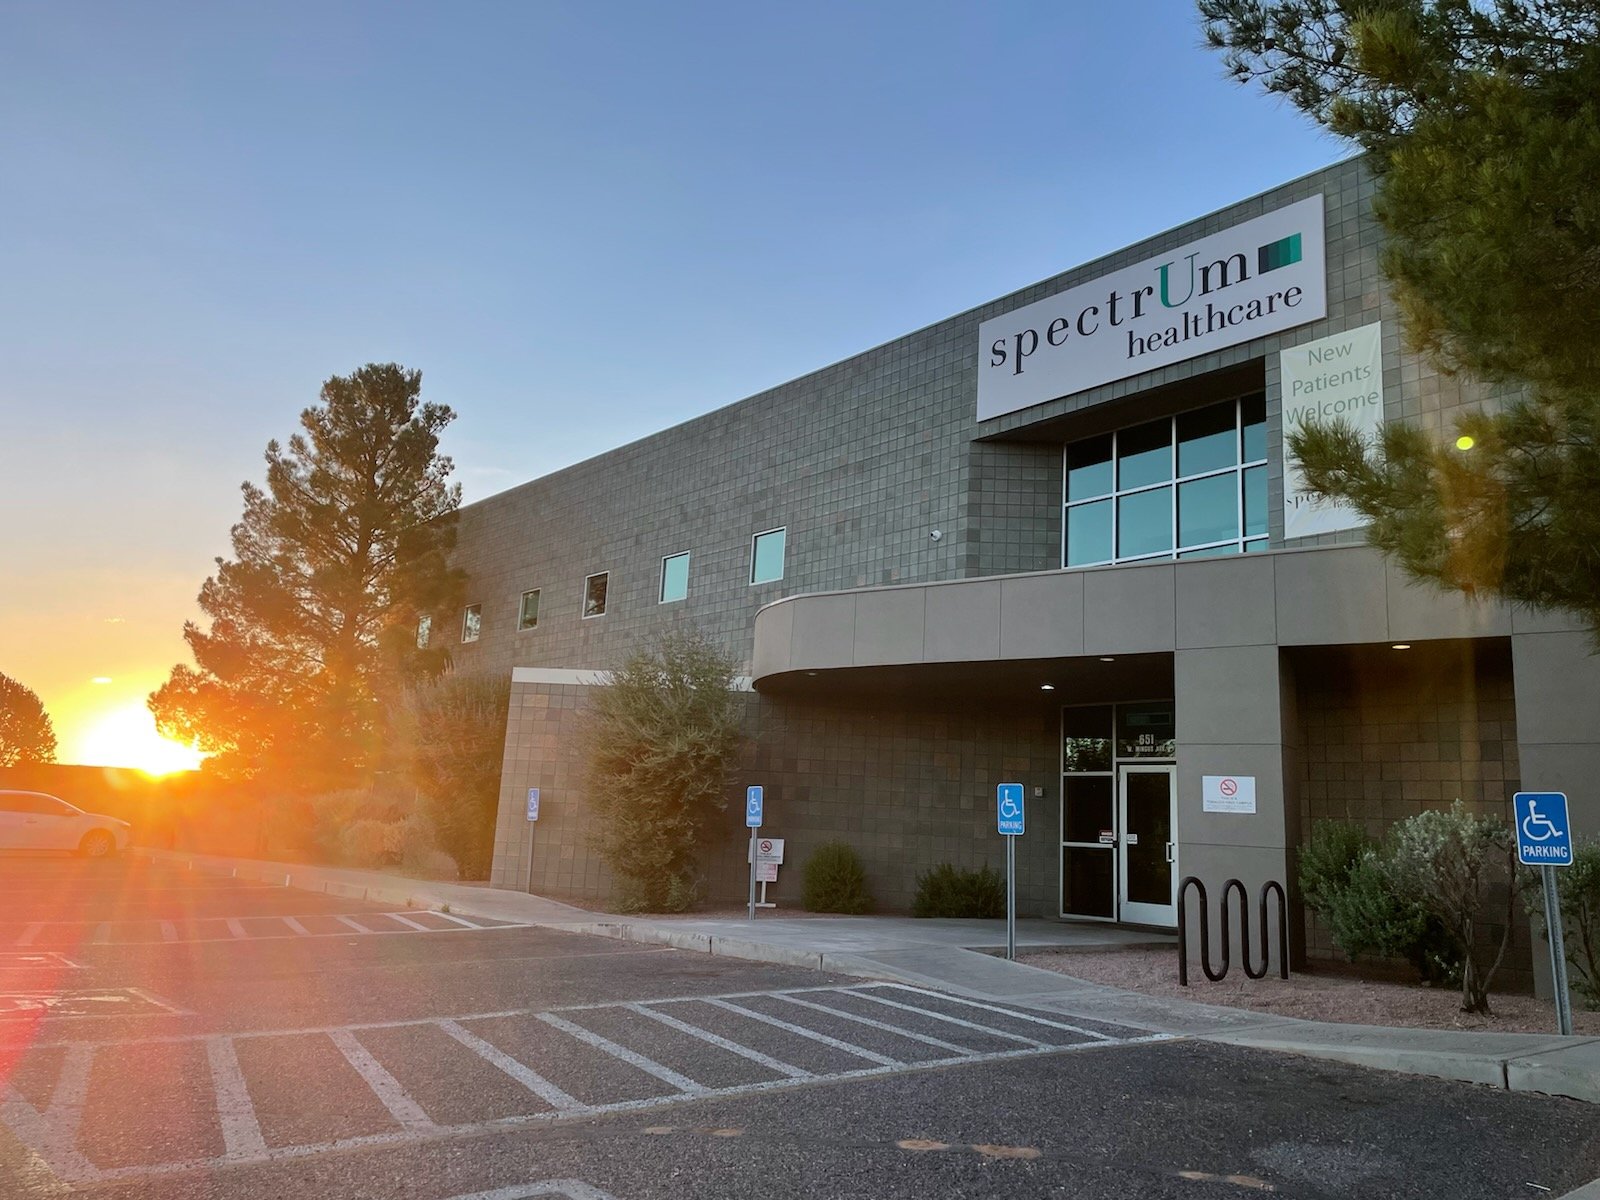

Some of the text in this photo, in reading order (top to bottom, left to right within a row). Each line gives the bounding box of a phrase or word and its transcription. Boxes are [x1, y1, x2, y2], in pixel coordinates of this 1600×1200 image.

[990, 251, 1252, 376] spectrUm
[1126, 286, 1302, 359] healthcare
[1308, 342, 1353, 366] New
[1292, 365, 1371, 397] Patients
[1286, 391, 1379, 425] Welcome
[1138, 734, 1155, 745] 651
[1522, 845, 1568, 858] PARKING
